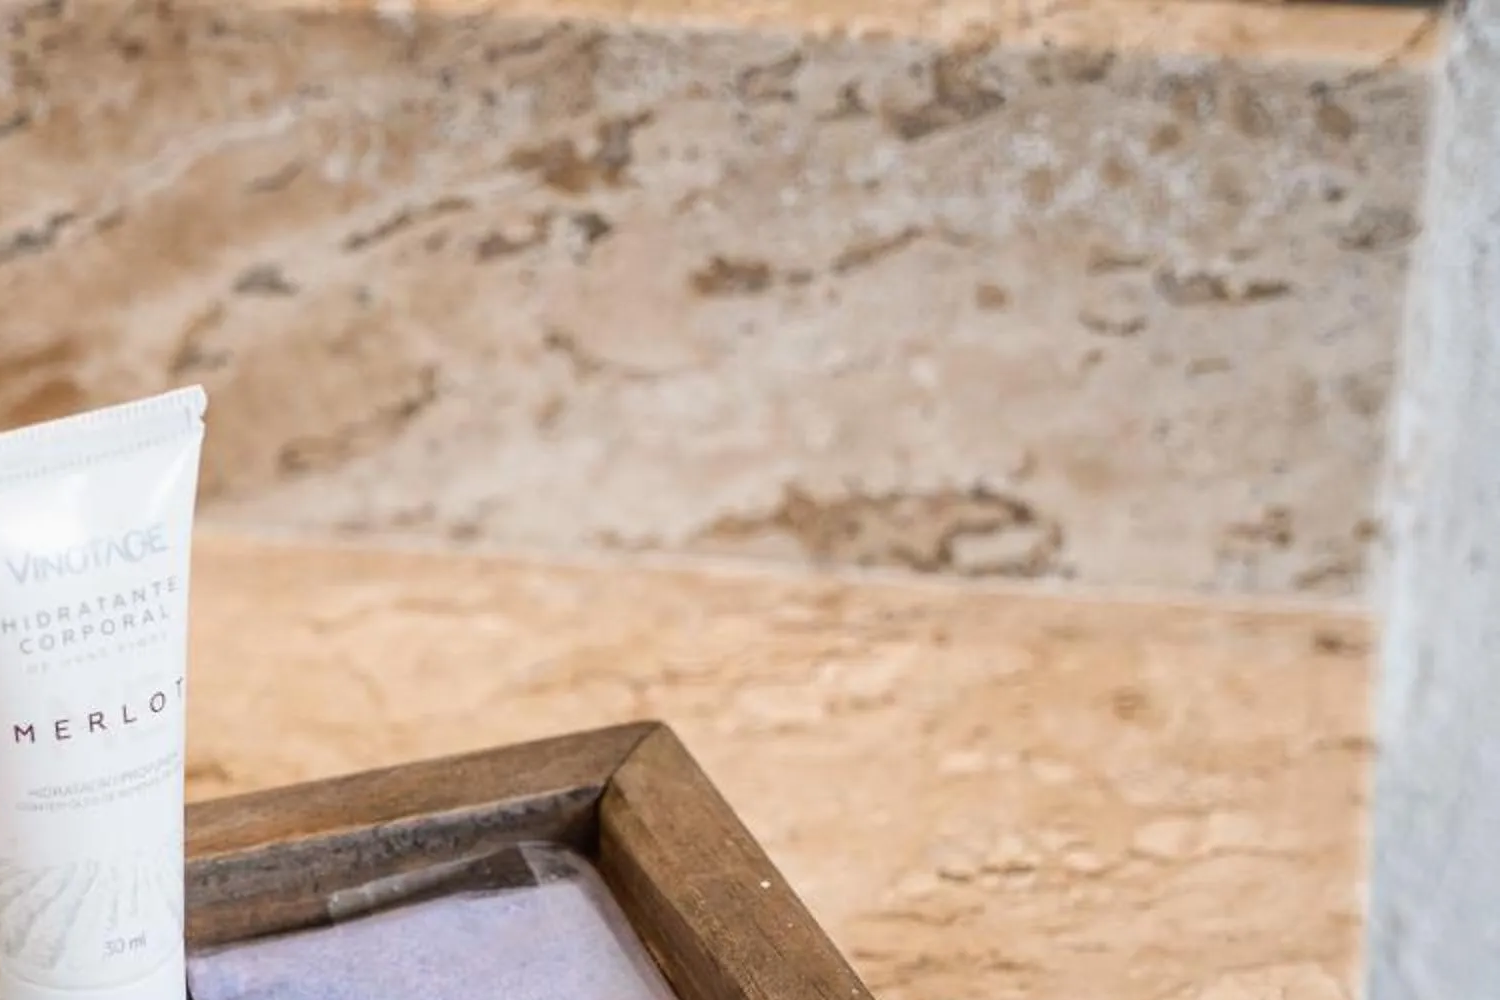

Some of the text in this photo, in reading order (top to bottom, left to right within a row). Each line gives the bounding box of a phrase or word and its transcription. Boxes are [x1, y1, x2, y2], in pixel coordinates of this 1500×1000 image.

[5, 522, 169, 586] VINOTAGE
[0, 576, 179, 634] HIDRATANTE
[18, 604, 170, 656] CORPORAL
[13, 676, 184, 744] MERLOT
